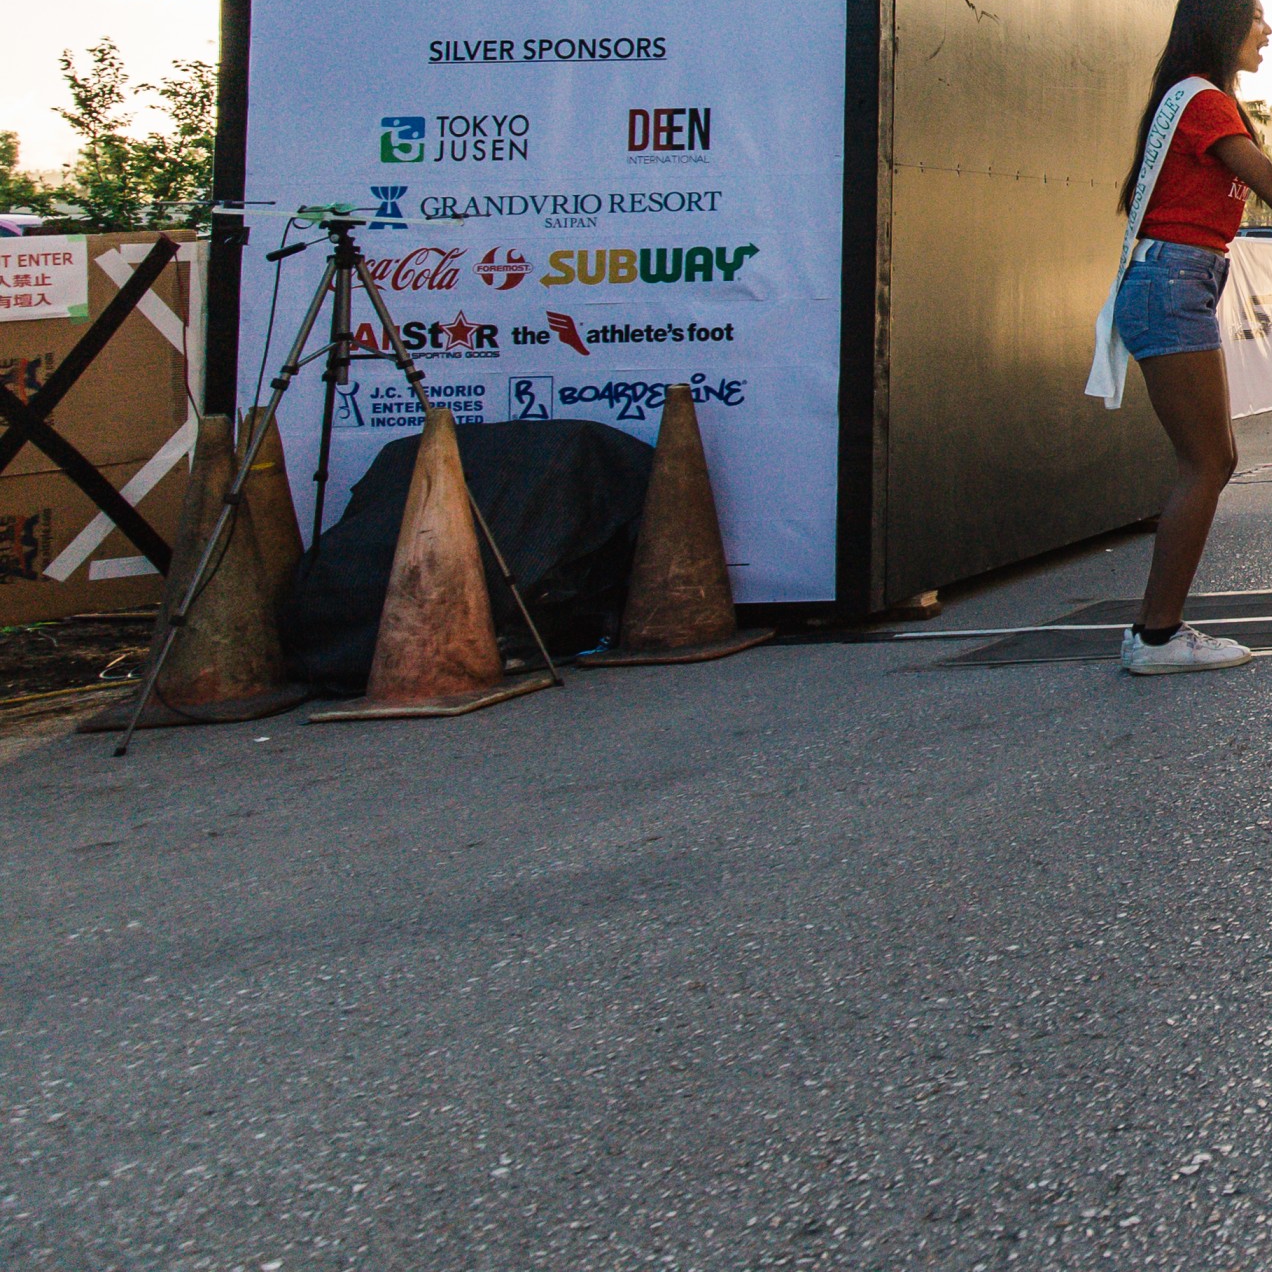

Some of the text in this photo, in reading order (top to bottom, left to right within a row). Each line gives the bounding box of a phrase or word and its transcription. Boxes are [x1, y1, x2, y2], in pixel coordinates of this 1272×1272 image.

[429, 37, 667, 63] SILVER SPONSORS
[436, 114, 530, 138] TOKYO
[627, 107, 711, 152] DEEN
[1145, 98, 1181, 170] RECYCLE
[433, 139, 528, 163] JUSEN
[627, 155, 710, 165] INTERNATIONAL
[420, 191, 722, 218] GRANDVRIO RESORT
[545, 217, 597, 228] SAIPAN
[18, 252, 74, 268] ENTER
[539, 243, 760, 287] SUBWAY
[511, 323, 734, 345] the athlete's foot
[412, 350, 500, 360] SPORTING GOODS
[370, 386, 402, 399] J.C.
